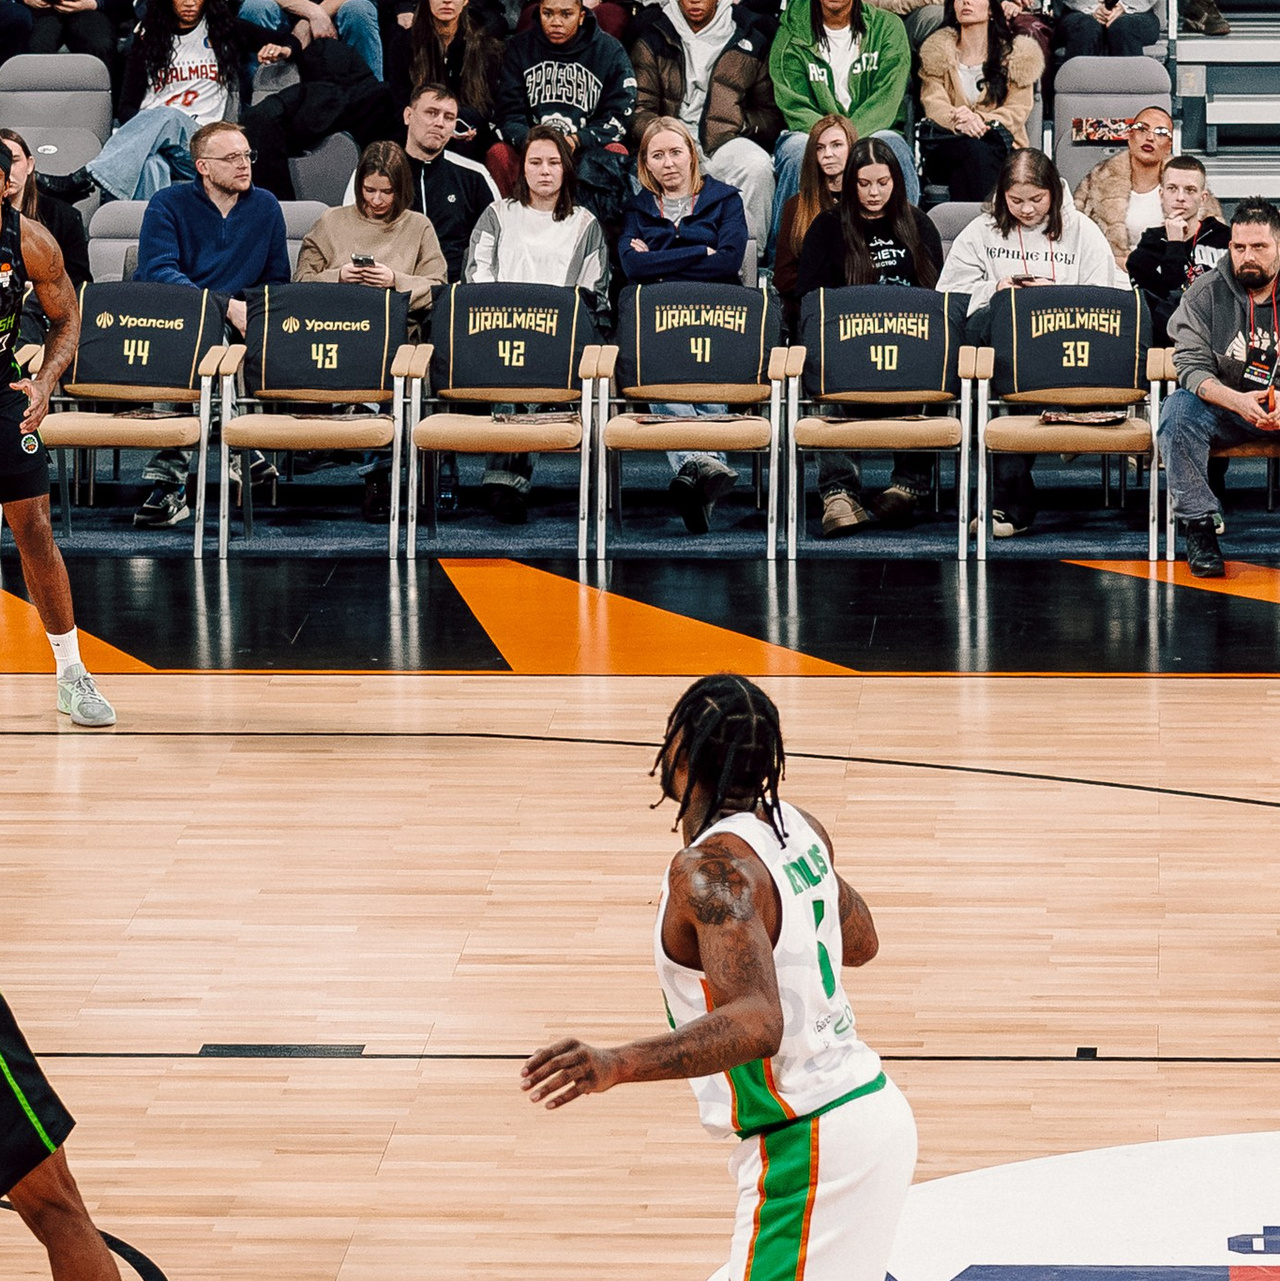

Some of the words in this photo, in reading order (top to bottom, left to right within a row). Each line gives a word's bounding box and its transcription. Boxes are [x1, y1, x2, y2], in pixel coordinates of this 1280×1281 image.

[118, 314, 184, 331] Уралсиб
[305, 318, 371, 333] Уралсиб
[468, 311, 559, 337] URALMASH
[654, 309, 747, 334] URALMASH
[838, 317, 930, 342] URALMASH
[1030, 312, 1121, 339] URALMASH
[123, 338, 151, 366] 44
[311, 342, 339, 369] 43
[497, 340, 526, 367] 42
[689, 336, 711, 363] 41
[869, 345, 899, 371] 40
[1061, 341, 1090, 367] 39
